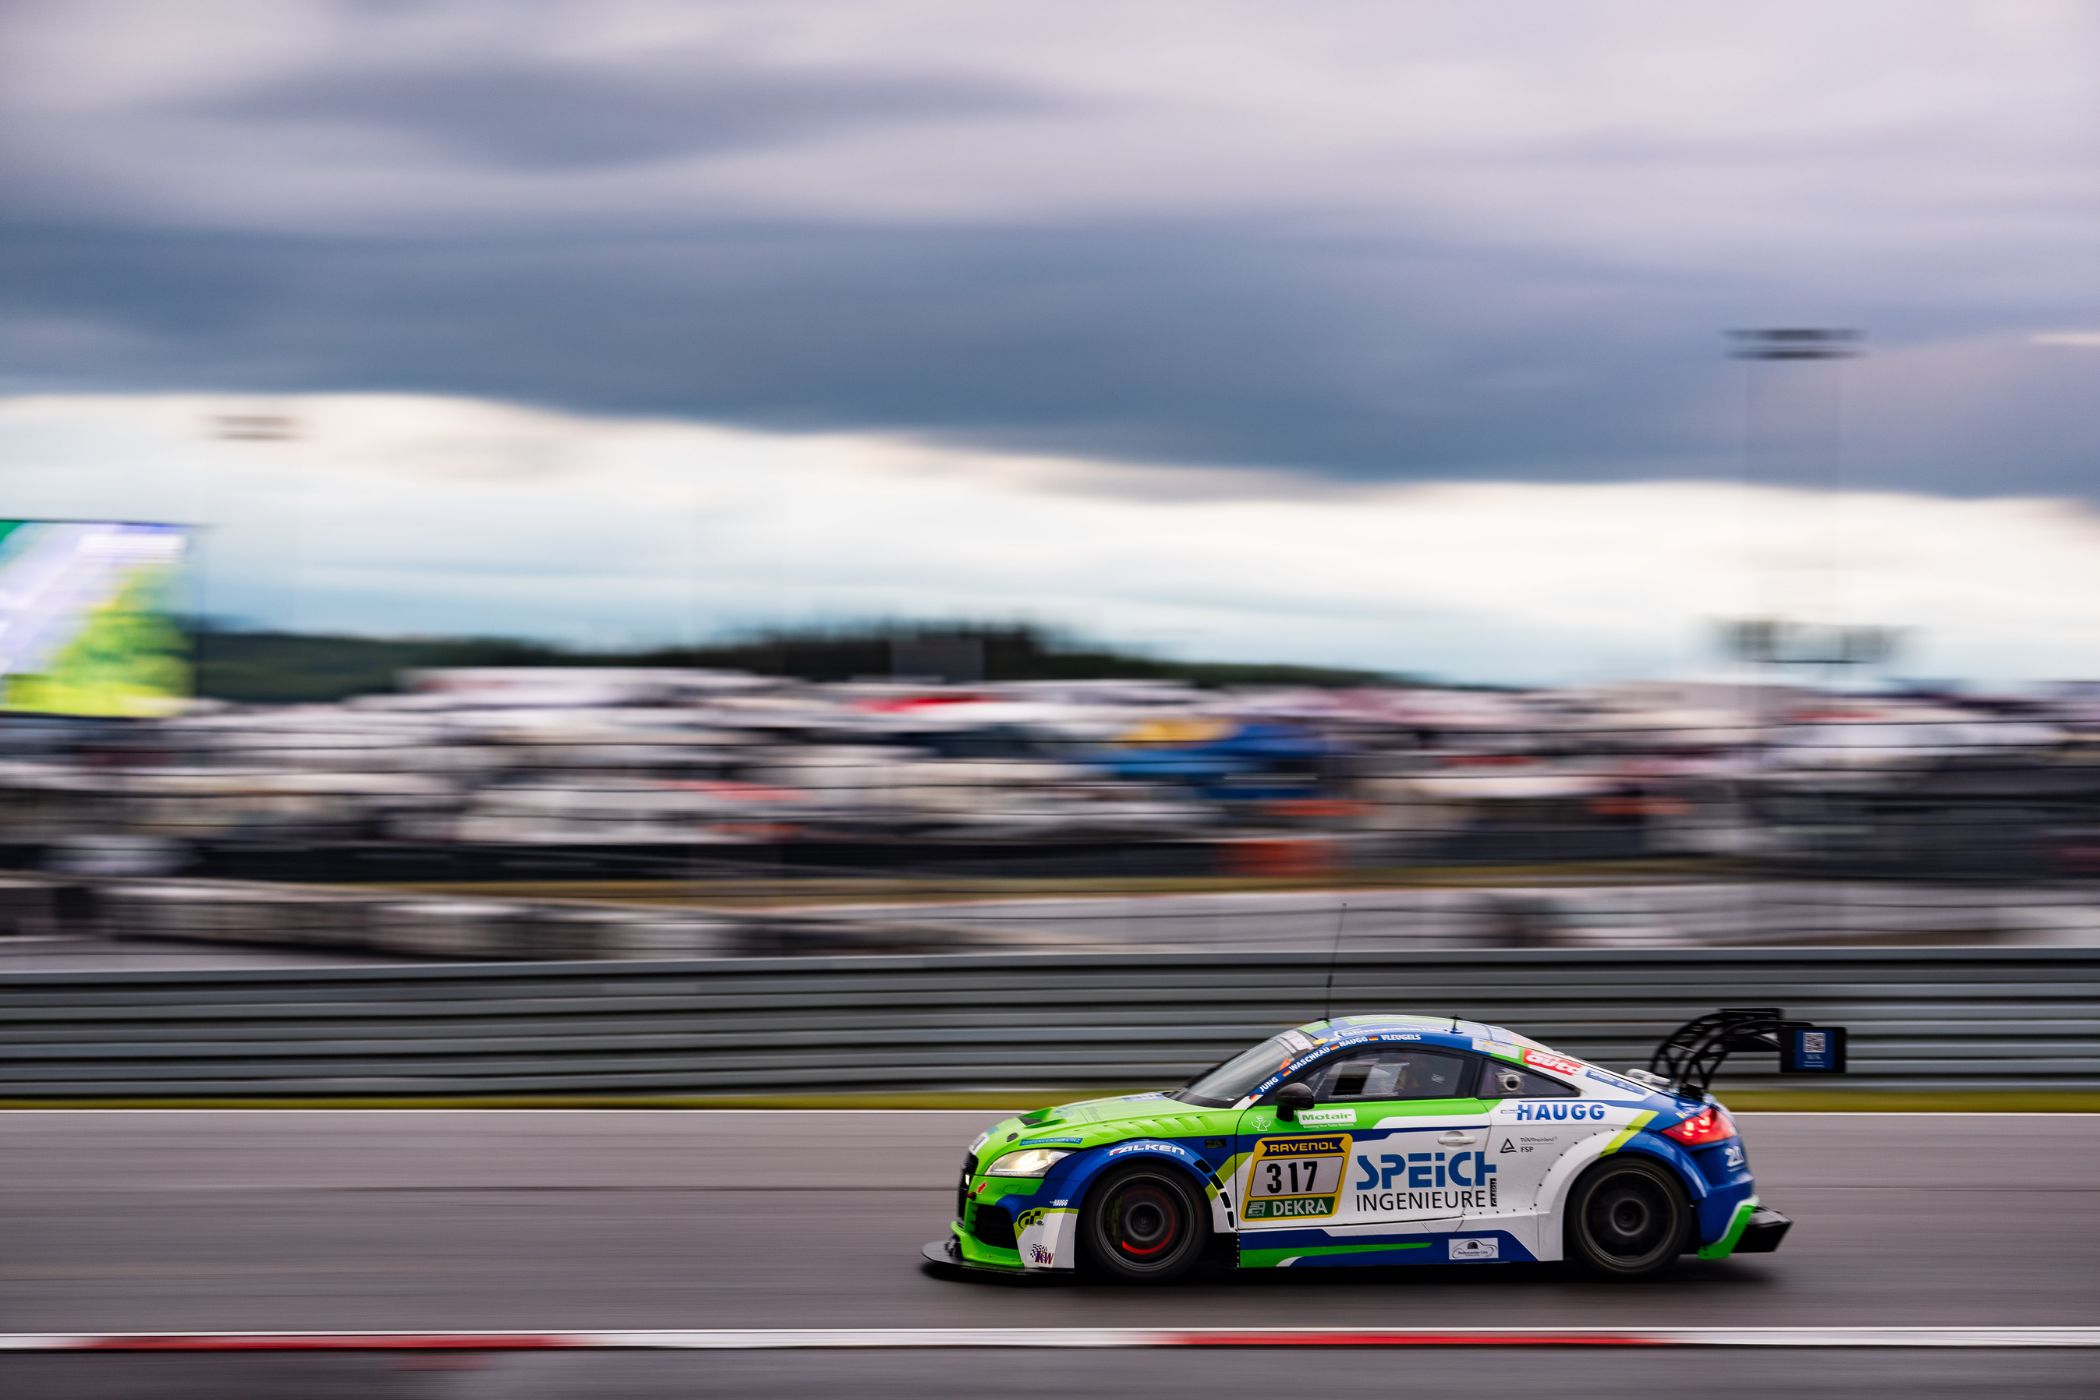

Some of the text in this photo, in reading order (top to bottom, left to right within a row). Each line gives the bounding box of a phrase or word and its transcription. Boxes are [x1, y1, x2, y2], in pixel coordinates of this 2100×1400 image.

[1259, 1076, 1279, 1092] JUNG
[1288, 1046, 1331, 1072] WASCHKAU
[1301, 1112, 1353, 1121] Motair
[1517, 1104, 1605, 1121] HAUGG
[1108, 1144, 1185, 1156] FALKEN
[1266, 1161, 1318, 1194] 317
[1272, 1199, 1328, 1216] DEKRA
[1356, 1190, 1486, 1212] INGENIEURE
